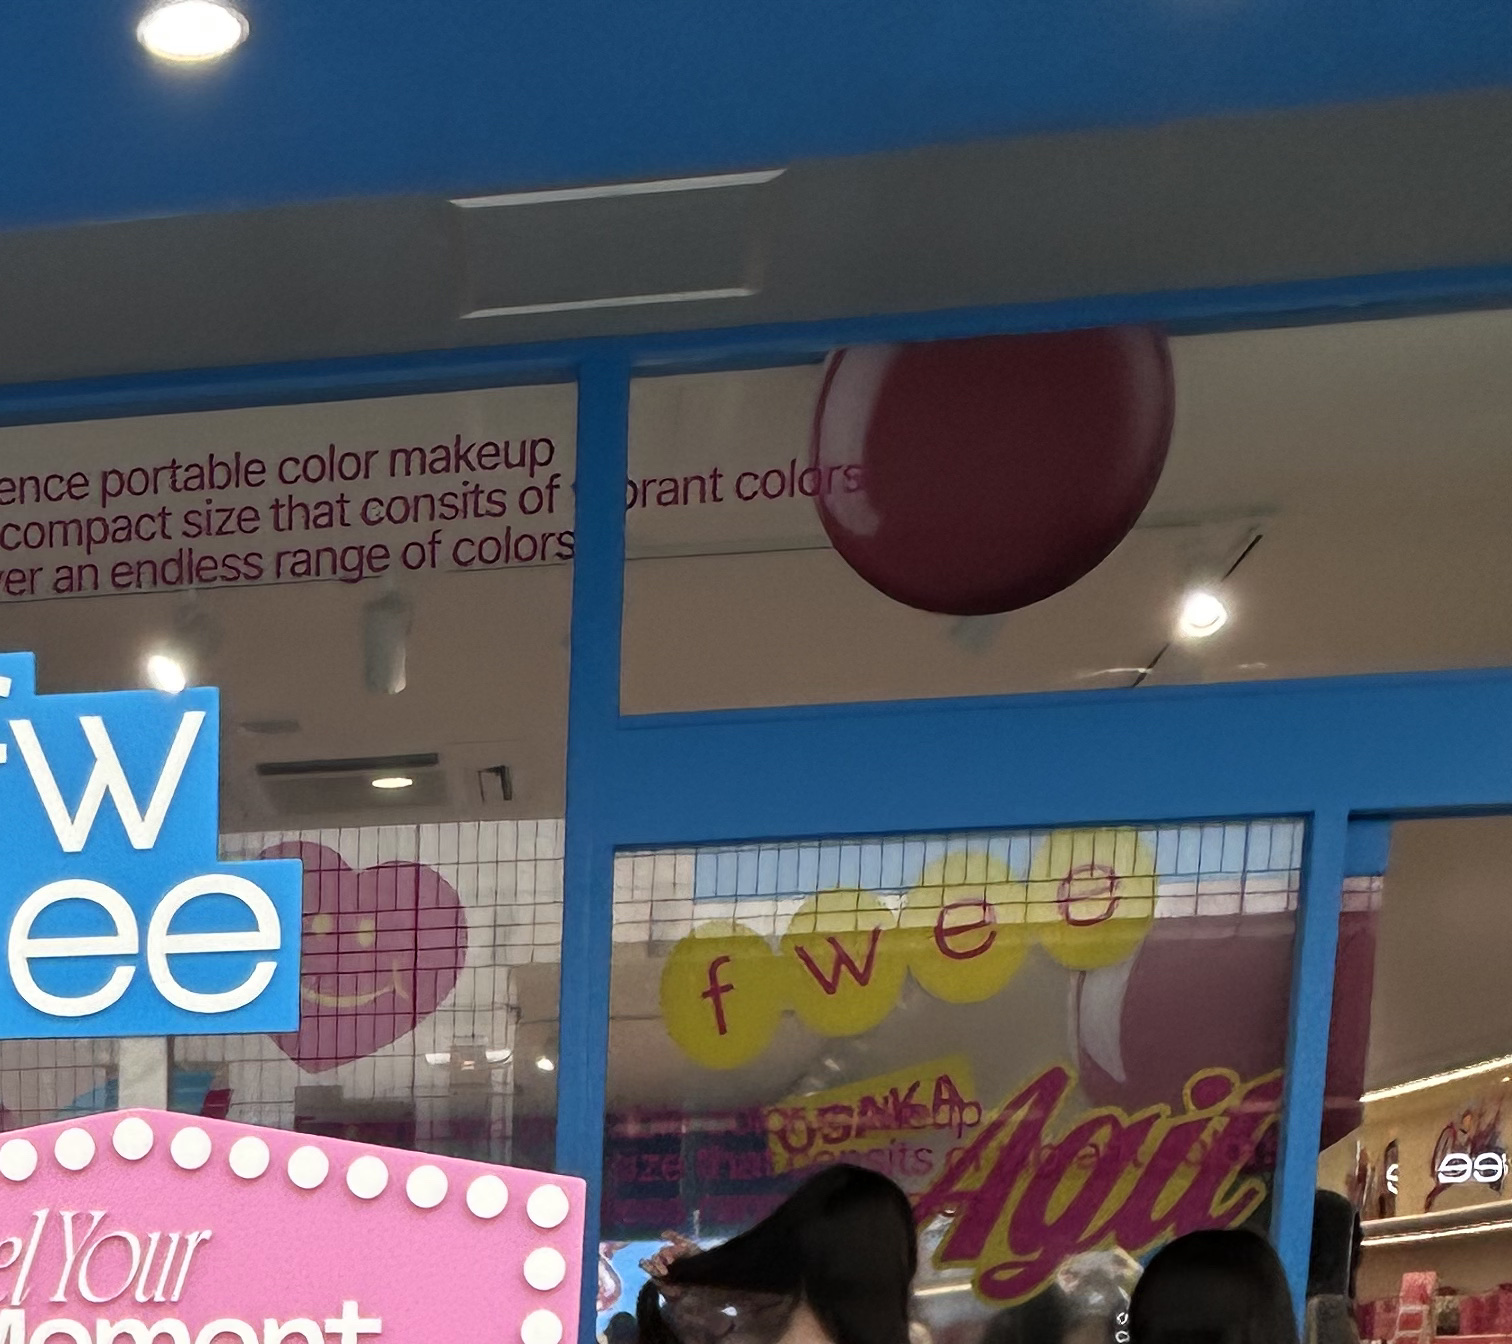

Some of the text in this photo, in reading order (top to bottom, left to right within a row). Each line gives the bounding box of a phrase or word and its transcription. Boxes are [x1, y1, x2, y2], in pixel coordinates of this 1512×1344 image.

[0, 506, 173, 555] compact
[182, 498, 261, 538] size
[270, 493, 350, 532] that
[360, 481, 507, 524] consits
[519, 473, 561, 515] of
[735, 458, 869, 500] colors
[101, 452, 265, 508] portable
[278, 444, 379, 485] color
[390, 434, 555, 478] makeup
[54, 561, 99, 594] an
[111, 547, 263, 589] endless
[276, 540, 390, 583] range
[401, 529, 443, 570] of
[452, 526, 575, 567] colors
[701, 864, 1120, 1036] fwee
[774, 1074, 964, 1153] OSAKA
[58, 1209, 212, 1304] Your
